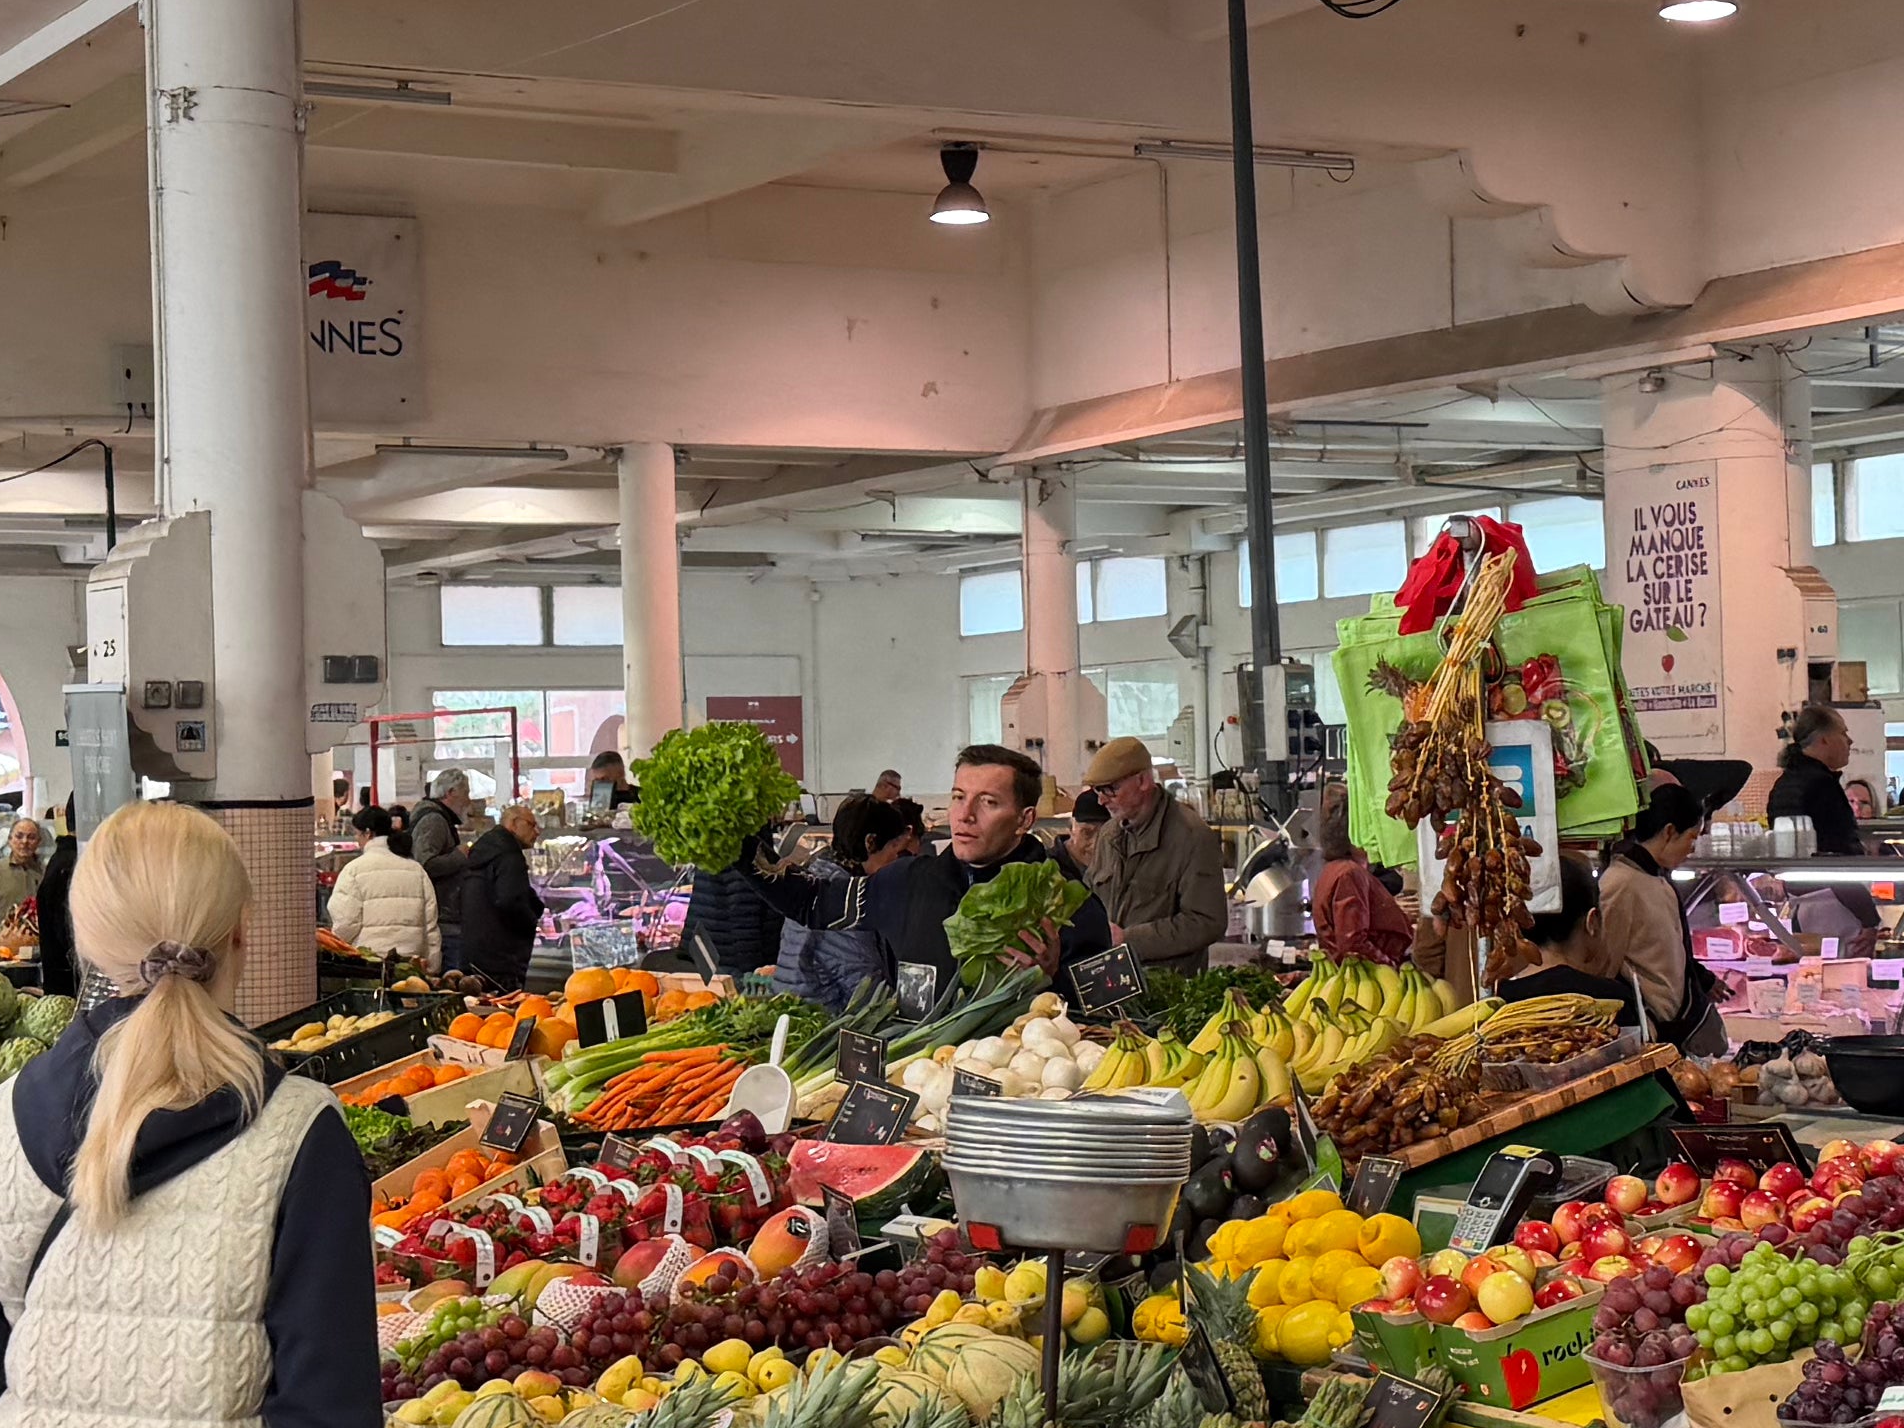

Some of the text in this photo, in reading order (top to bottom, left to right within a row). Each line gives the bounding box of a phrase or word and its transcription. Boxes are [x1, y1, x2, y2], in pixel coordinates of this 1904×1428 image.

[1634, 501, 1697, 531] IL VOUS
[1629, 526, 1705, 558] MANQUE
[1626, 551, 1708, 583] LA CERISE
[1643, 578, 1693, 606] SUR LE
[103, 630, 116, 657] 25
